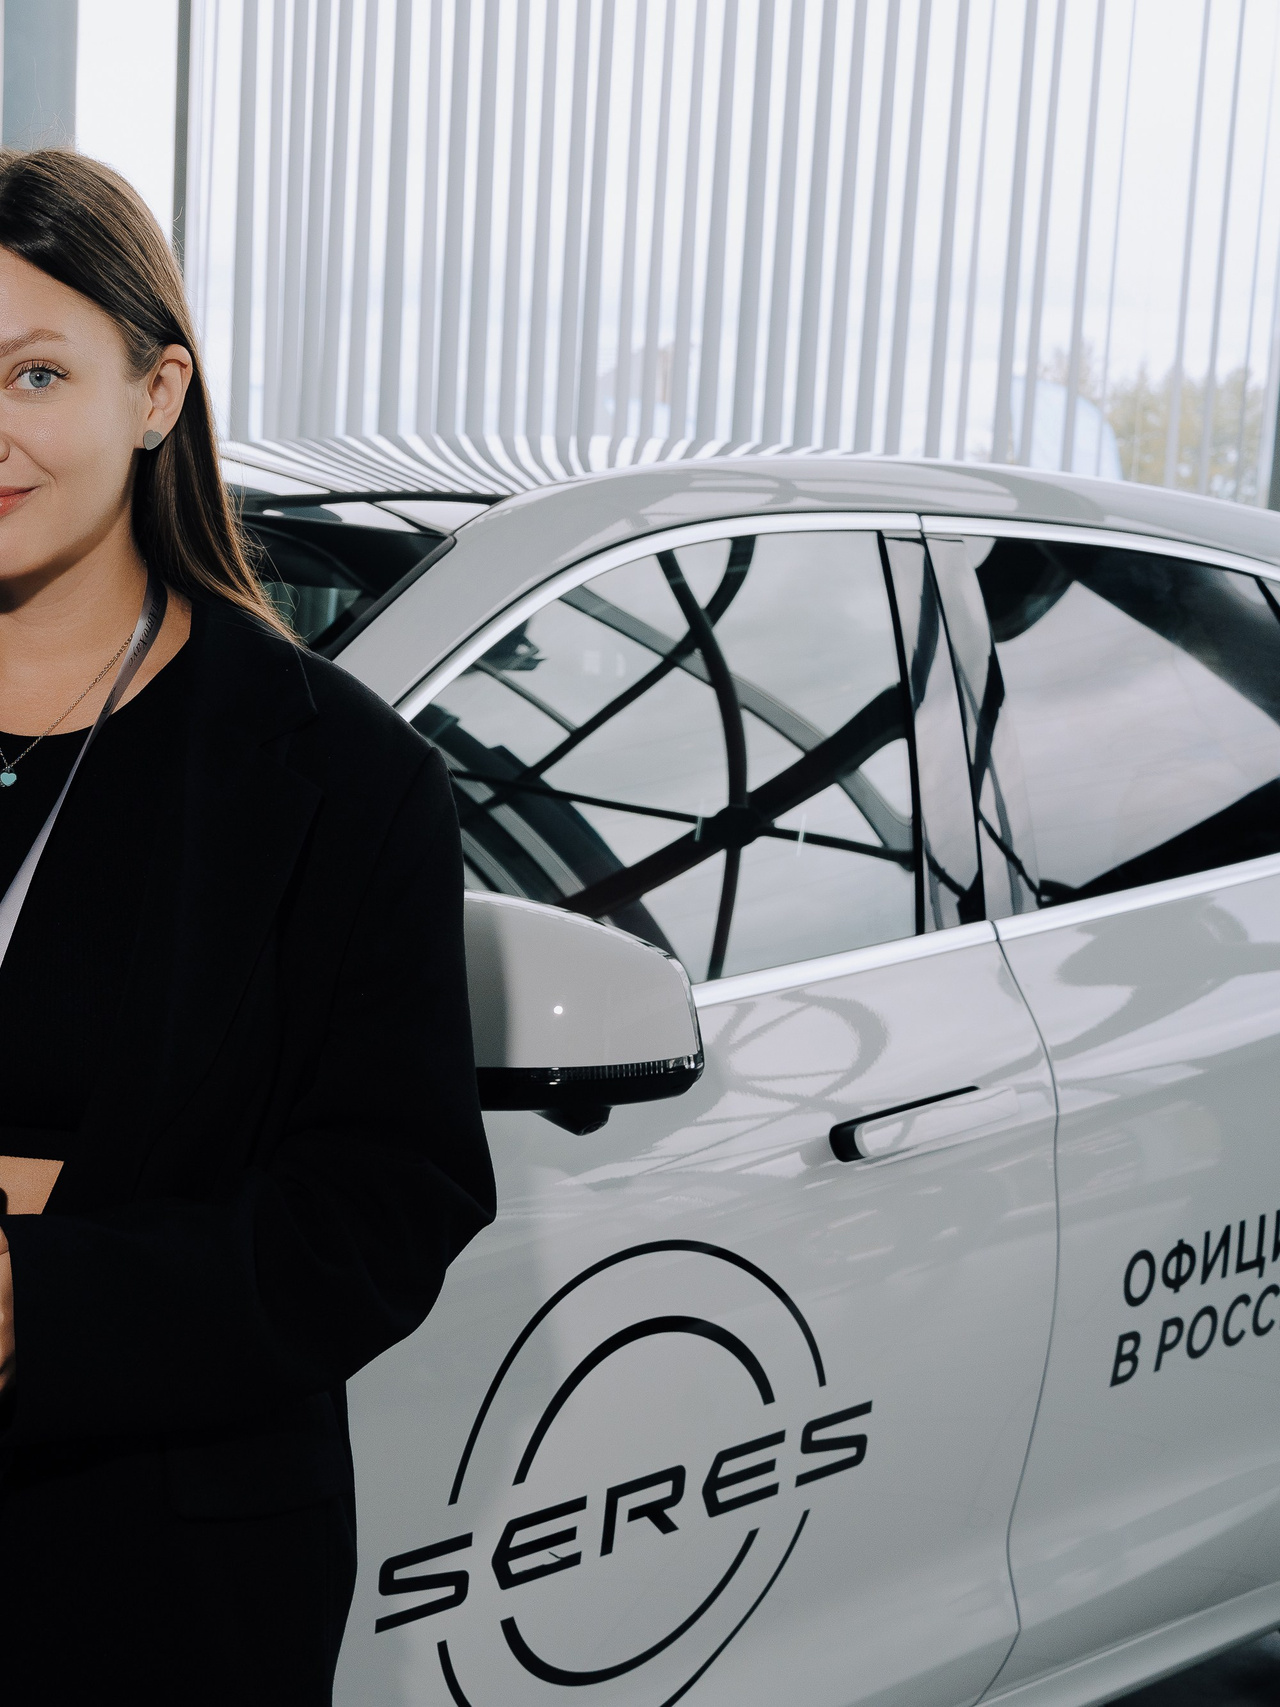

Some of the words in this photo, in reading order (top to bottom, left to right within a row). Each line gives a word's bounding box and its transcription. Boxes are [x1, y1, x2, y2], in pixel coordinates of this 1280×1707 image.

[1110, 1330, 1141, 1387] В
[1153, 1283, 1280, 1372] РОСС
[374, 1400, 873, 1635] SERES
